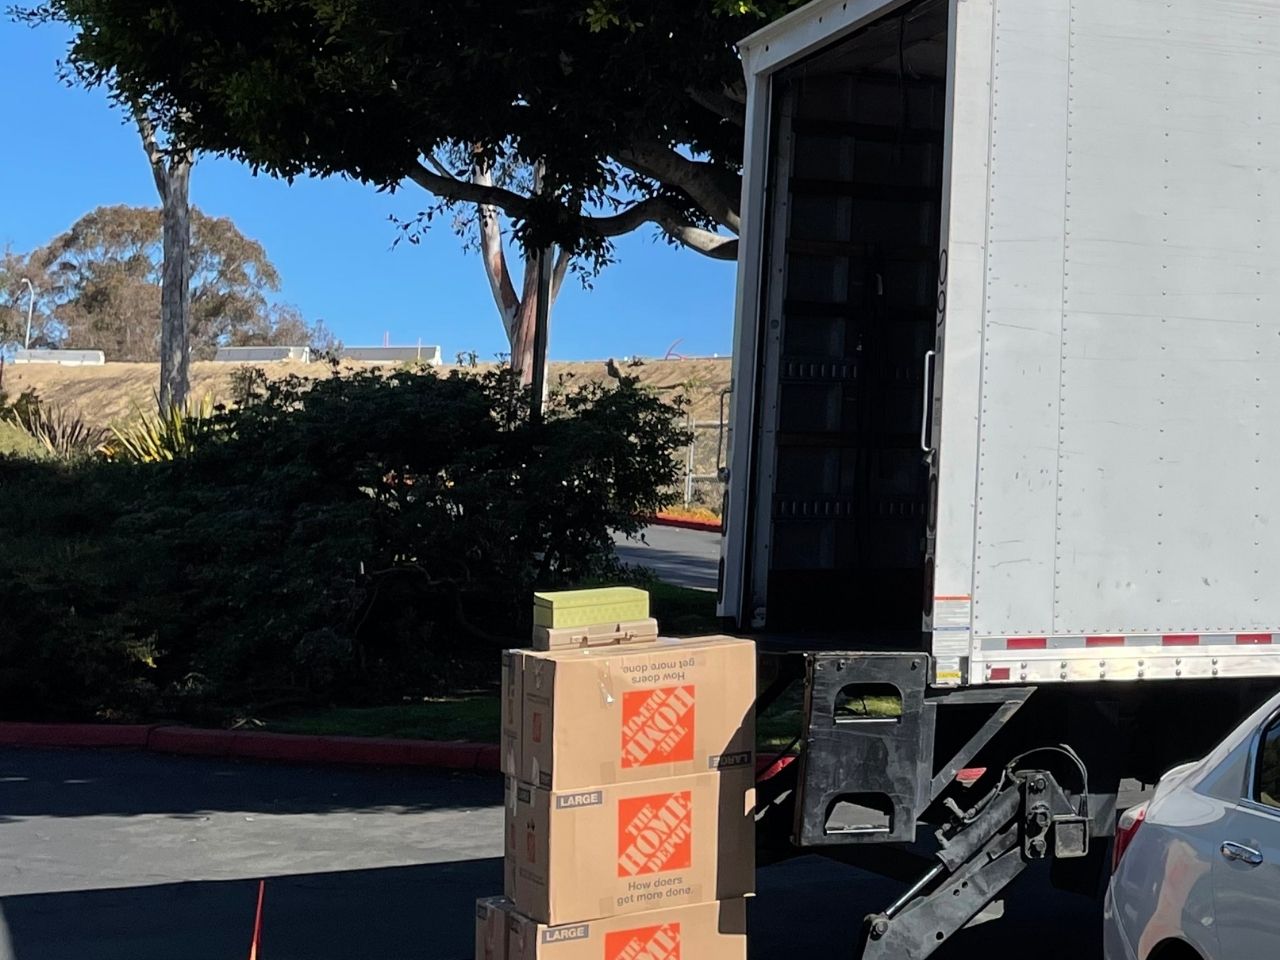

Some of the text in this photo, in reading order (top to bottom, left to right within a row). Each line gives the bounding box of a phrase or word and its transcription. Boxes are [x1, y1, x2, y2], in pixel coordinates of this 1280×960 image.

[650, 661, 677, 672] more
[679, 657, 695, 668] get
[632, 671, 685, 685] How doers
[622, 689, 667, 740] DEPOT
[621, 686, 695, 768] HOME
[658, 724, 689, 756] THE
[712, 753, 749, 767] LARGE
[559, 793, 599, 807] LARGE
[625, 802, 657, 837] THE
[618, 792, 692, 876] HOME
[647, 818, 692, 873] DEPOT
[628, 877, 683, 891] How doers
[636, 891, 663, 902] more
[545, 926, 585, 941] LARGE
[615, 936, 645, 960] HE
